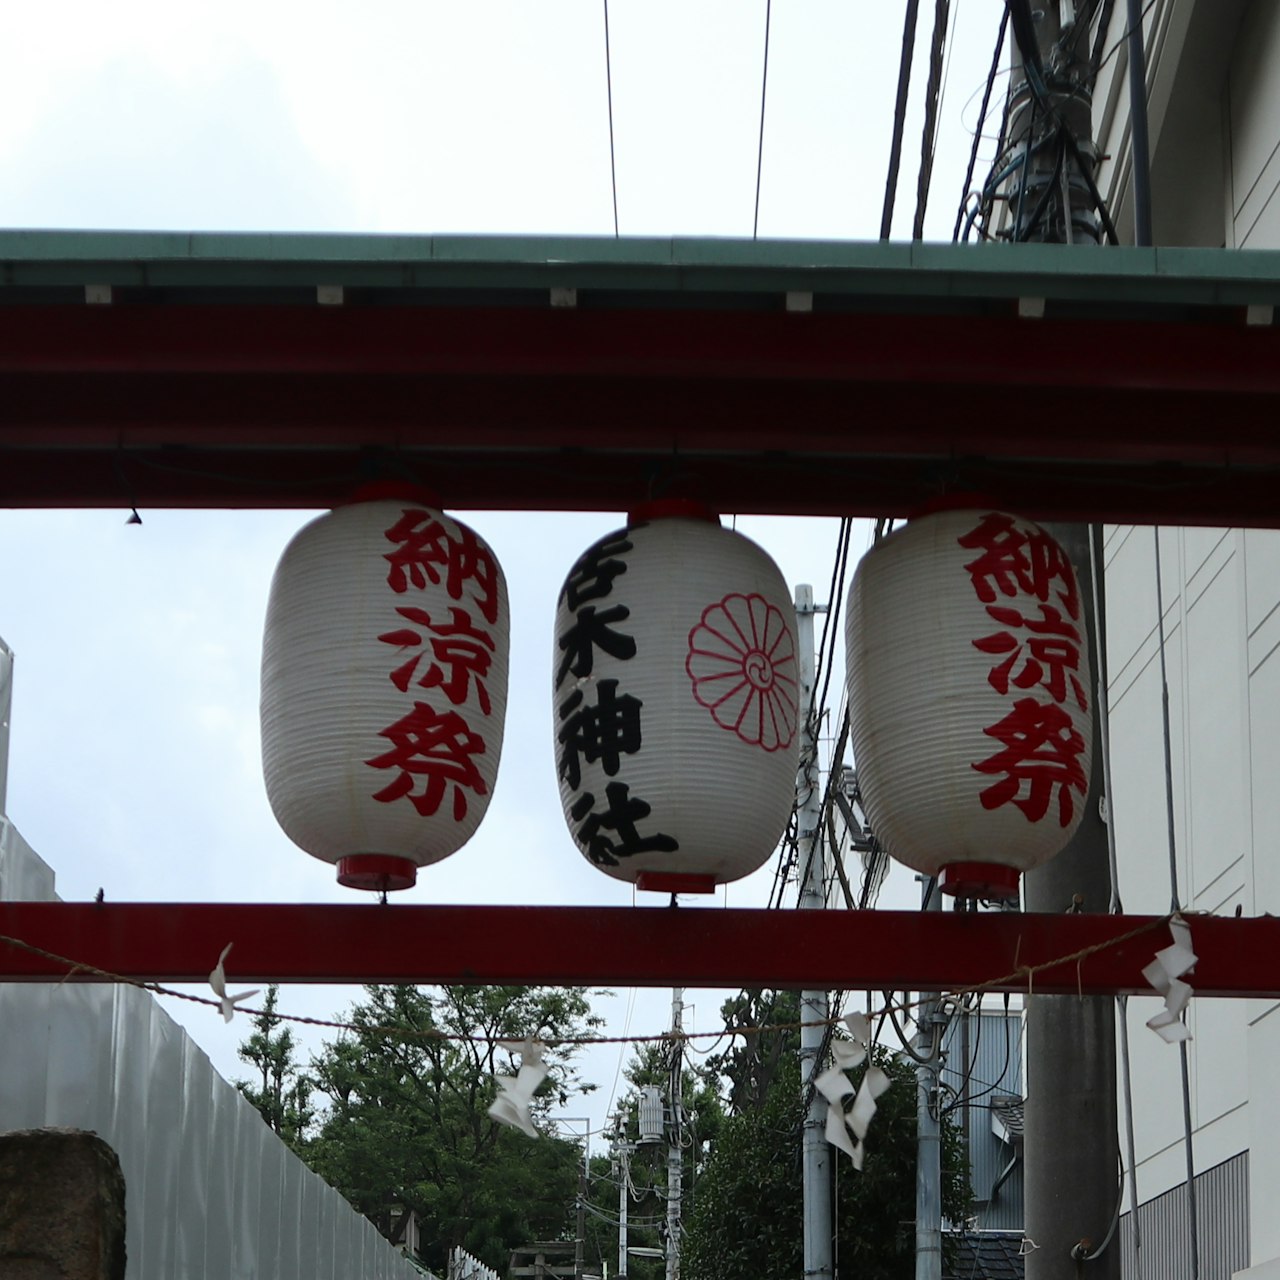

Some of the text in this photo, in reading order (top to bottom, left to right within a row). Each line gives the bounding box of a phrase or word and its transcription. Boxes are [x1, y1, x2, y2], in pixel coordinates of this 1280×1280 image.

[365, 508, 500, 824] 納涼祭
[956, 511, 1089, 828] 納涼祭
